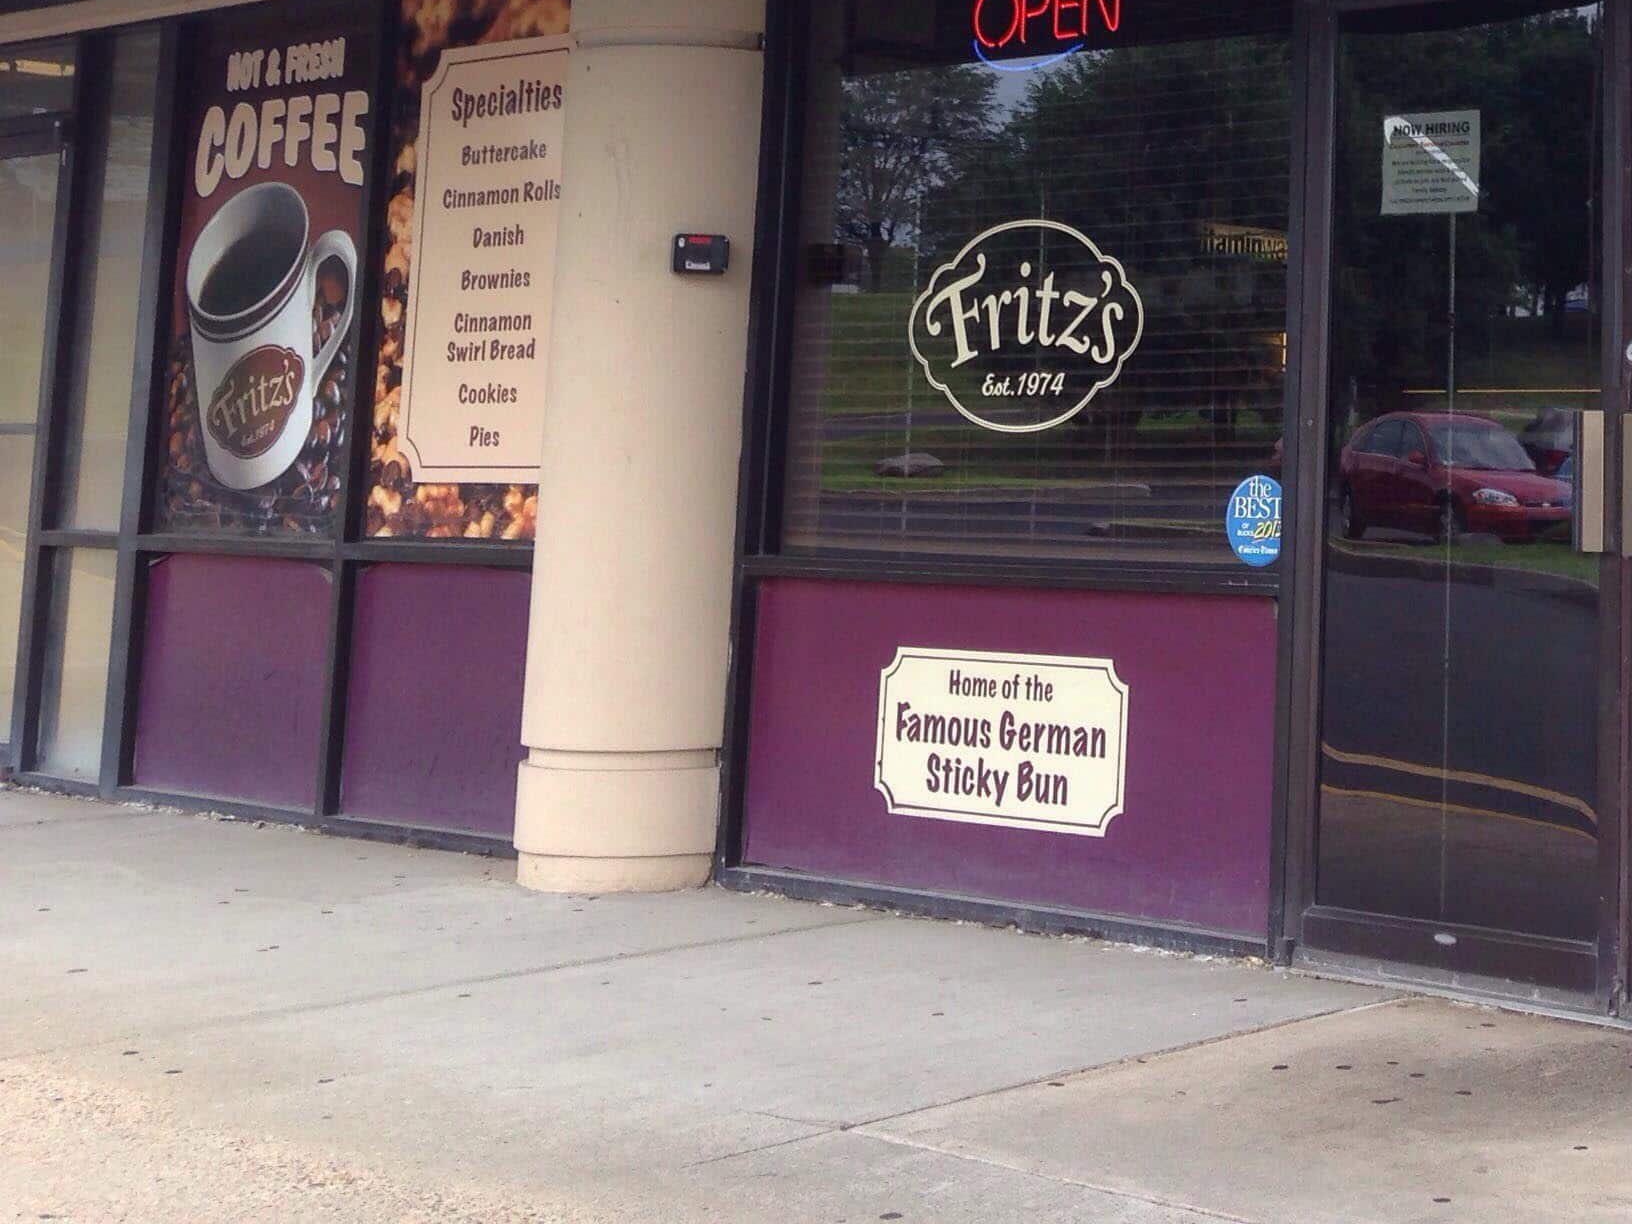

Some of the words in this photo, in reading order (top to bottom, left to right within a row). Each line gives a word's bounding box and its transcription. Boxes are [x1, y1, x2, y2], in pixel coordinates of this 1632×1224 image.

[265, 48, 281, 87] &
[285, 37, 346, 84] FRESH
[451, 79, 563, 128] Specialties
[1425, 120, 1470, 136] HIRING
[195, 90, 369, 197] COFFEE
[461, 138, 547, 166] Buttercake
[442, 187, 519, 209] Cinnamon
[523, 179, 562, 203] Rolls
[472, 224, 525, 249] Danish
[461, 268, 532, 291] Brownies
[454, 312, 532, 333] Cinnamon
[926, 253, 1124, 368] Fritz's
[446, 340, 486, 363] Swirl
[489, 338, 536, 360] Bread
[212, 358, 295, 436] Fritz's
[458, 382, 518, 405] Cookies
[981, 372, 1066, 397] Est.1974
[469, 425, 500, 447] Pies
[1249, 475, 1273, 498] the
[1234, 496, 1282, 519] BEST
[949, 669, 998, 699] Home
[1001, 673, 1021, 701] of
[1025, 674, 1054, 703] the
[895, 701, 992, 749] Famous
[999, 710, 1107, 759] German
[925, 752, 1010, 807] Sticky
[1016, 760, 1069, 806] Bun
